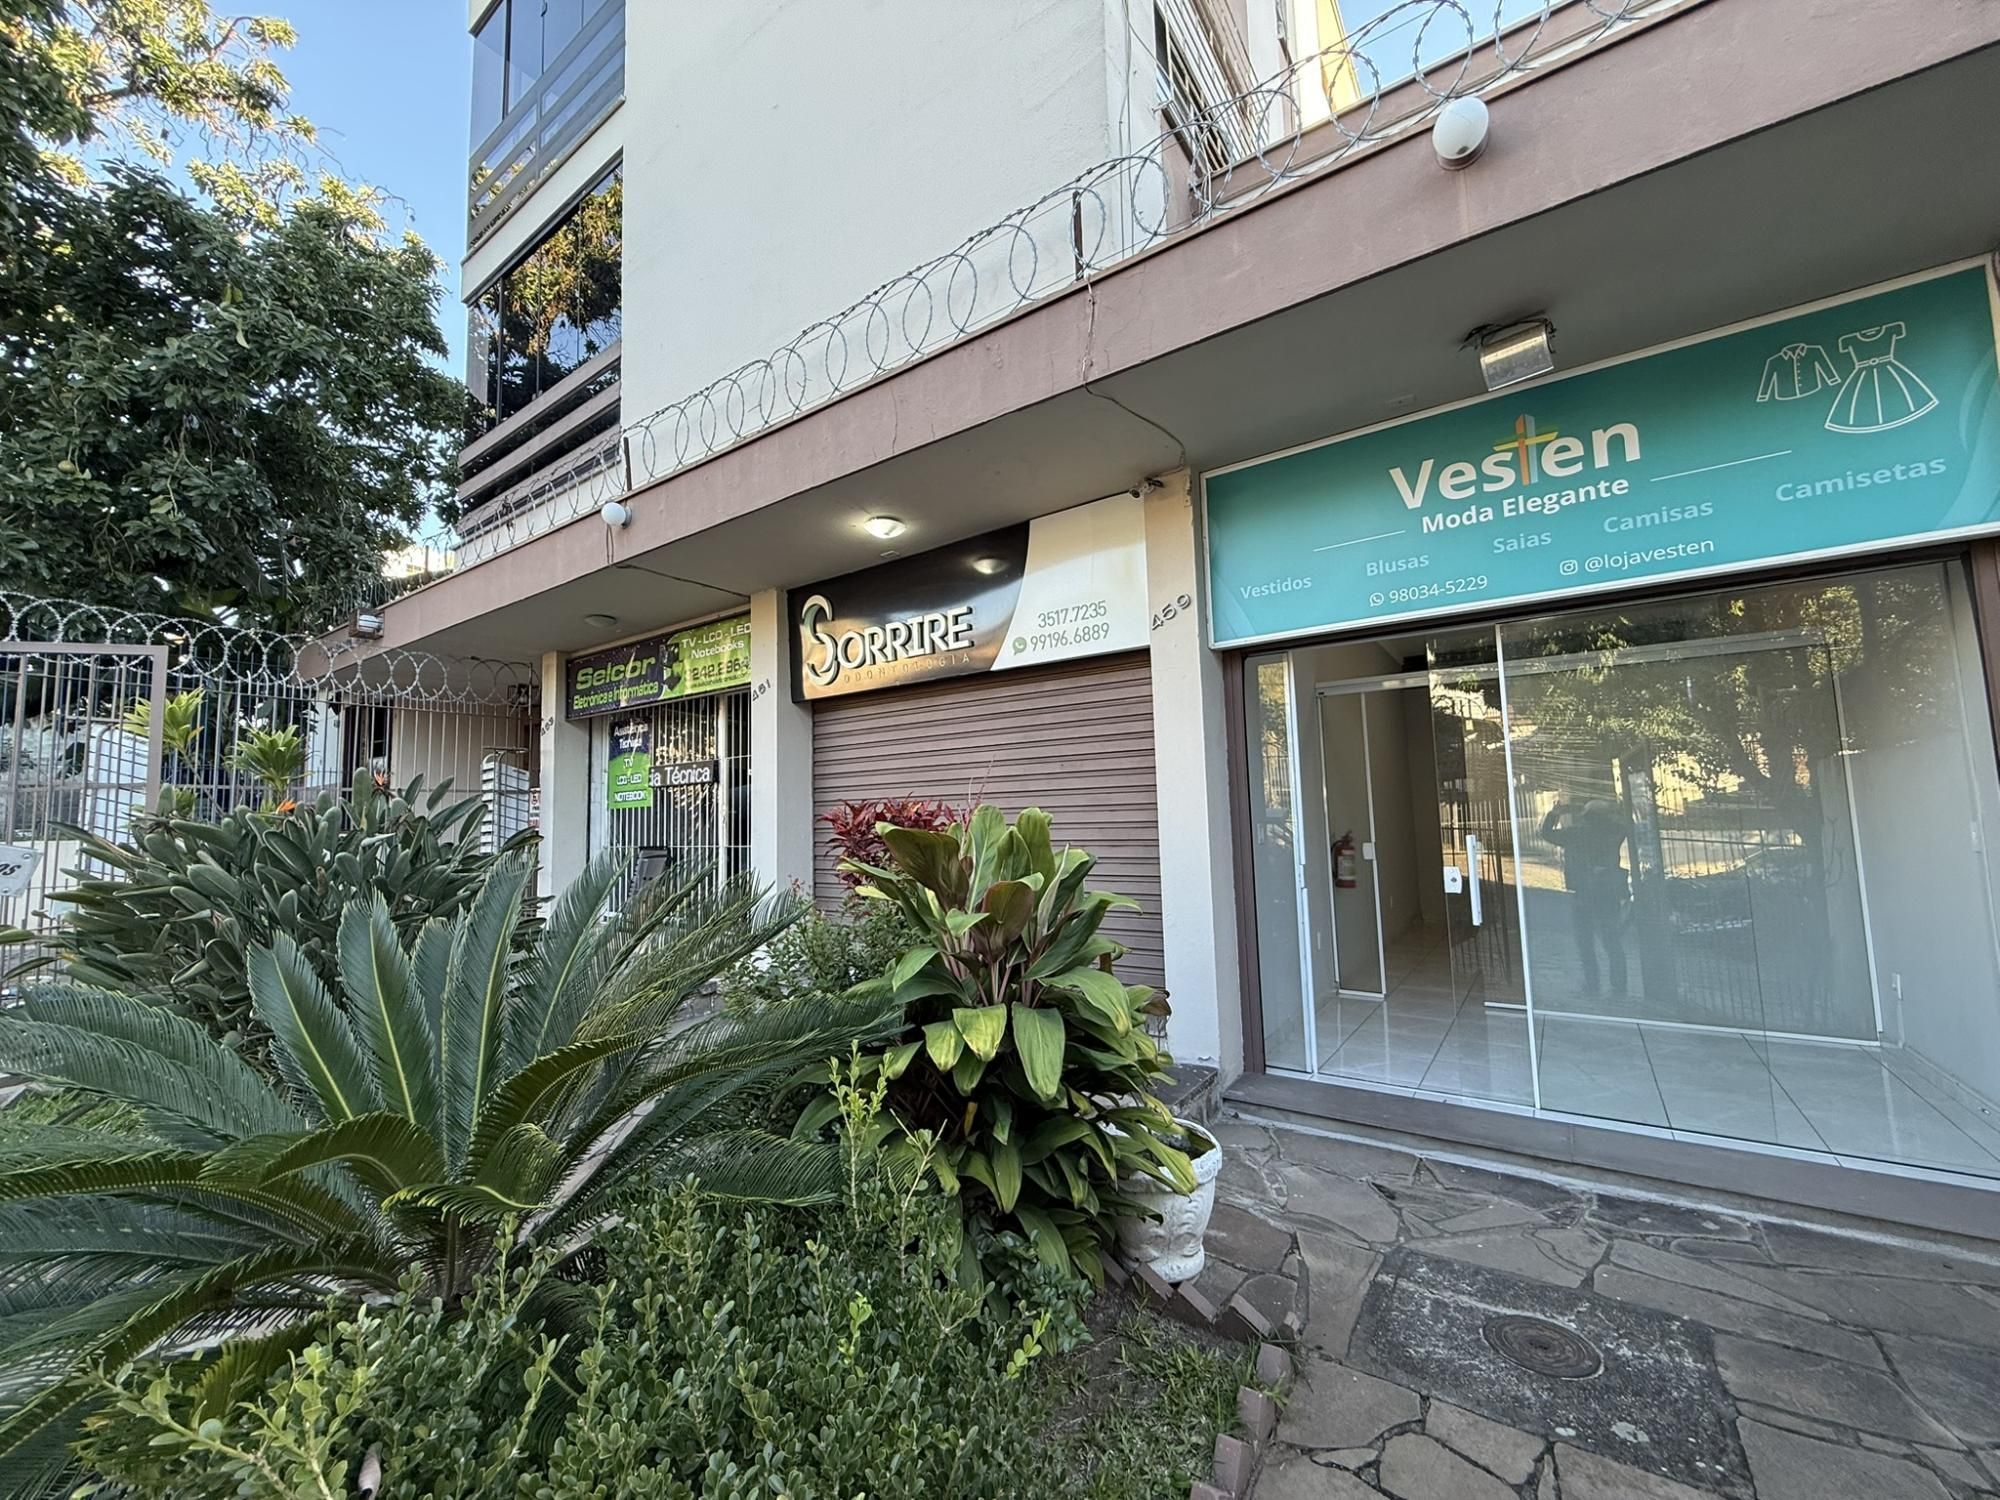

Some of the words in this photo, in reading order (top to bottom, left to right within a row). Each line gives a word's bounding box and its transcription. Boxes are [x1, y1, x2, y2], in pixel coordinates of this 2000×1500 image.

[1389, 414, 1641, 510] Vesten
[1775, 456, 1947, 502] Camisetas
[1422, 505, 1493, 533] Moda
[1503, 478, 1629, 517] Elegante
[1603, 501, 1714, 534] Camisas
[1493, 530, 1552, 554] Saias
[1584, 539, 1714, 573] @lojavesten
[1366, 554, 1430, 577] Blusas
[1240, 576, 1312, 600] Vestidos
[1389, 575, 1488, 604] 98034-5229
[1038, 600, 1107, 628] 3517.7235
[1152, 593, 1192, 631] 459
[681, 637, 697, 649] TV
[703, 630, 723, 644] LCD
[730, 623, 751, 637] LED
[691, 640, 744, 659] Notebooks
[802, 594, 975, 686] SORRIRE
[1030, 622, 1110, 652] 99196.6889
[576, 656, 656, 690] Selcor
[844, 653, 971, 684] ODONTOLOGIA
[665, 764, 710, 785] Técnica
